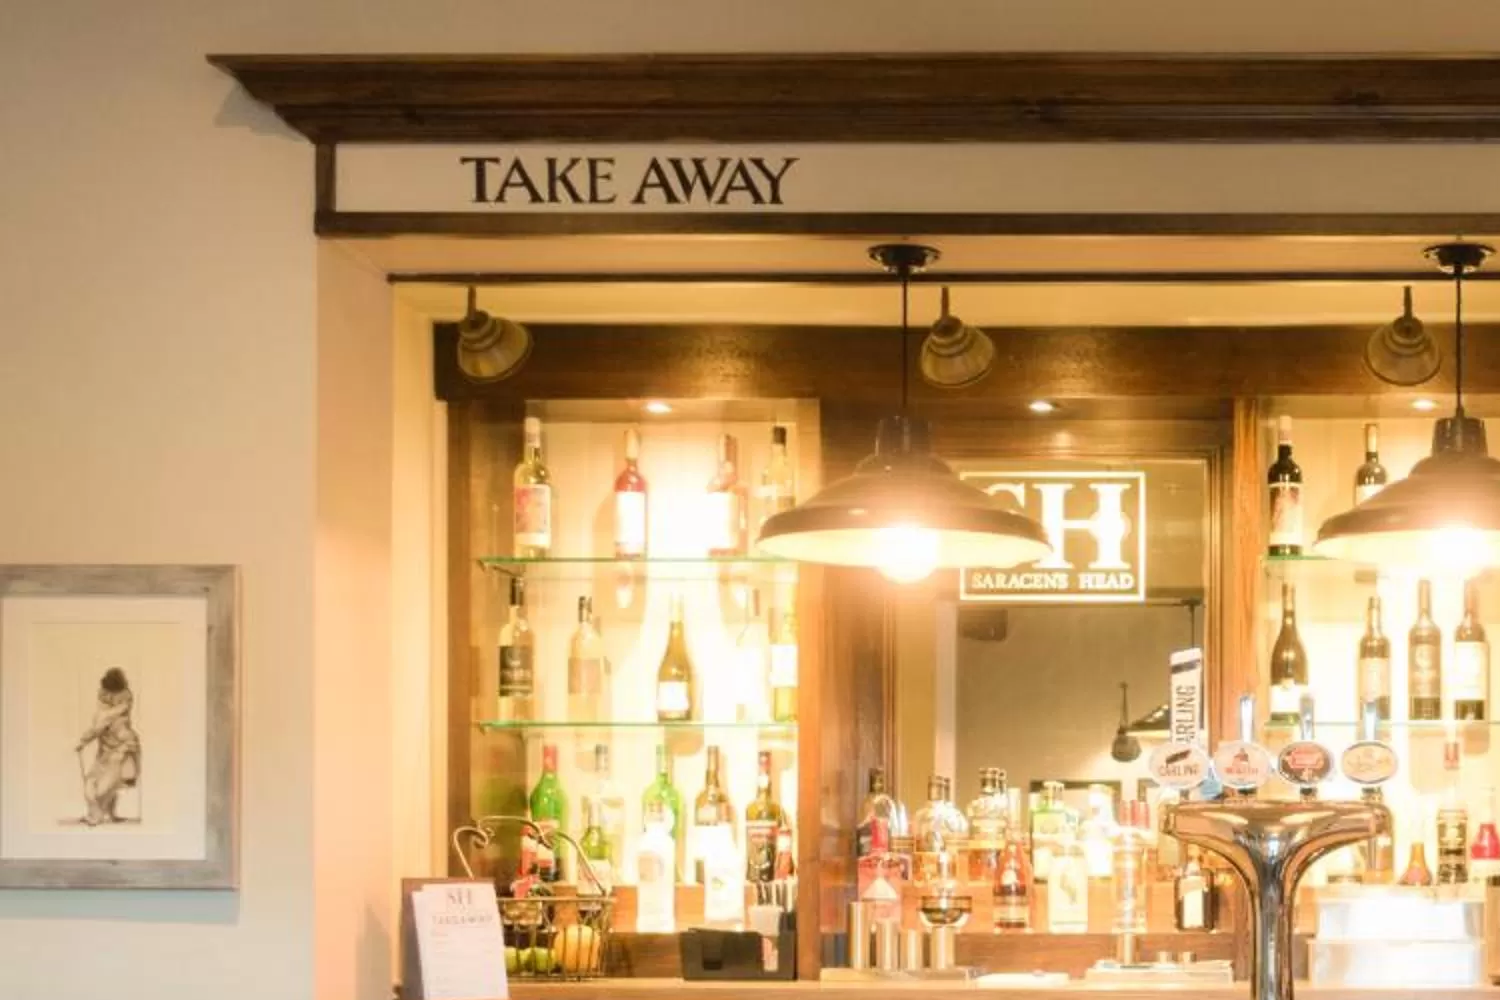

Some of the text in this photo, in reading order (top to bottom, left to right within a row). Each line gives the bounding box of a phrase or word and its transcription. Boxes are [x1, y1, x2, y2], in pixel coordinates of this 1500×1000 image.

[460, 156, 800, 205] TAKE AWAY
[971, 572, 1134, 590] SARACENS HEAD
